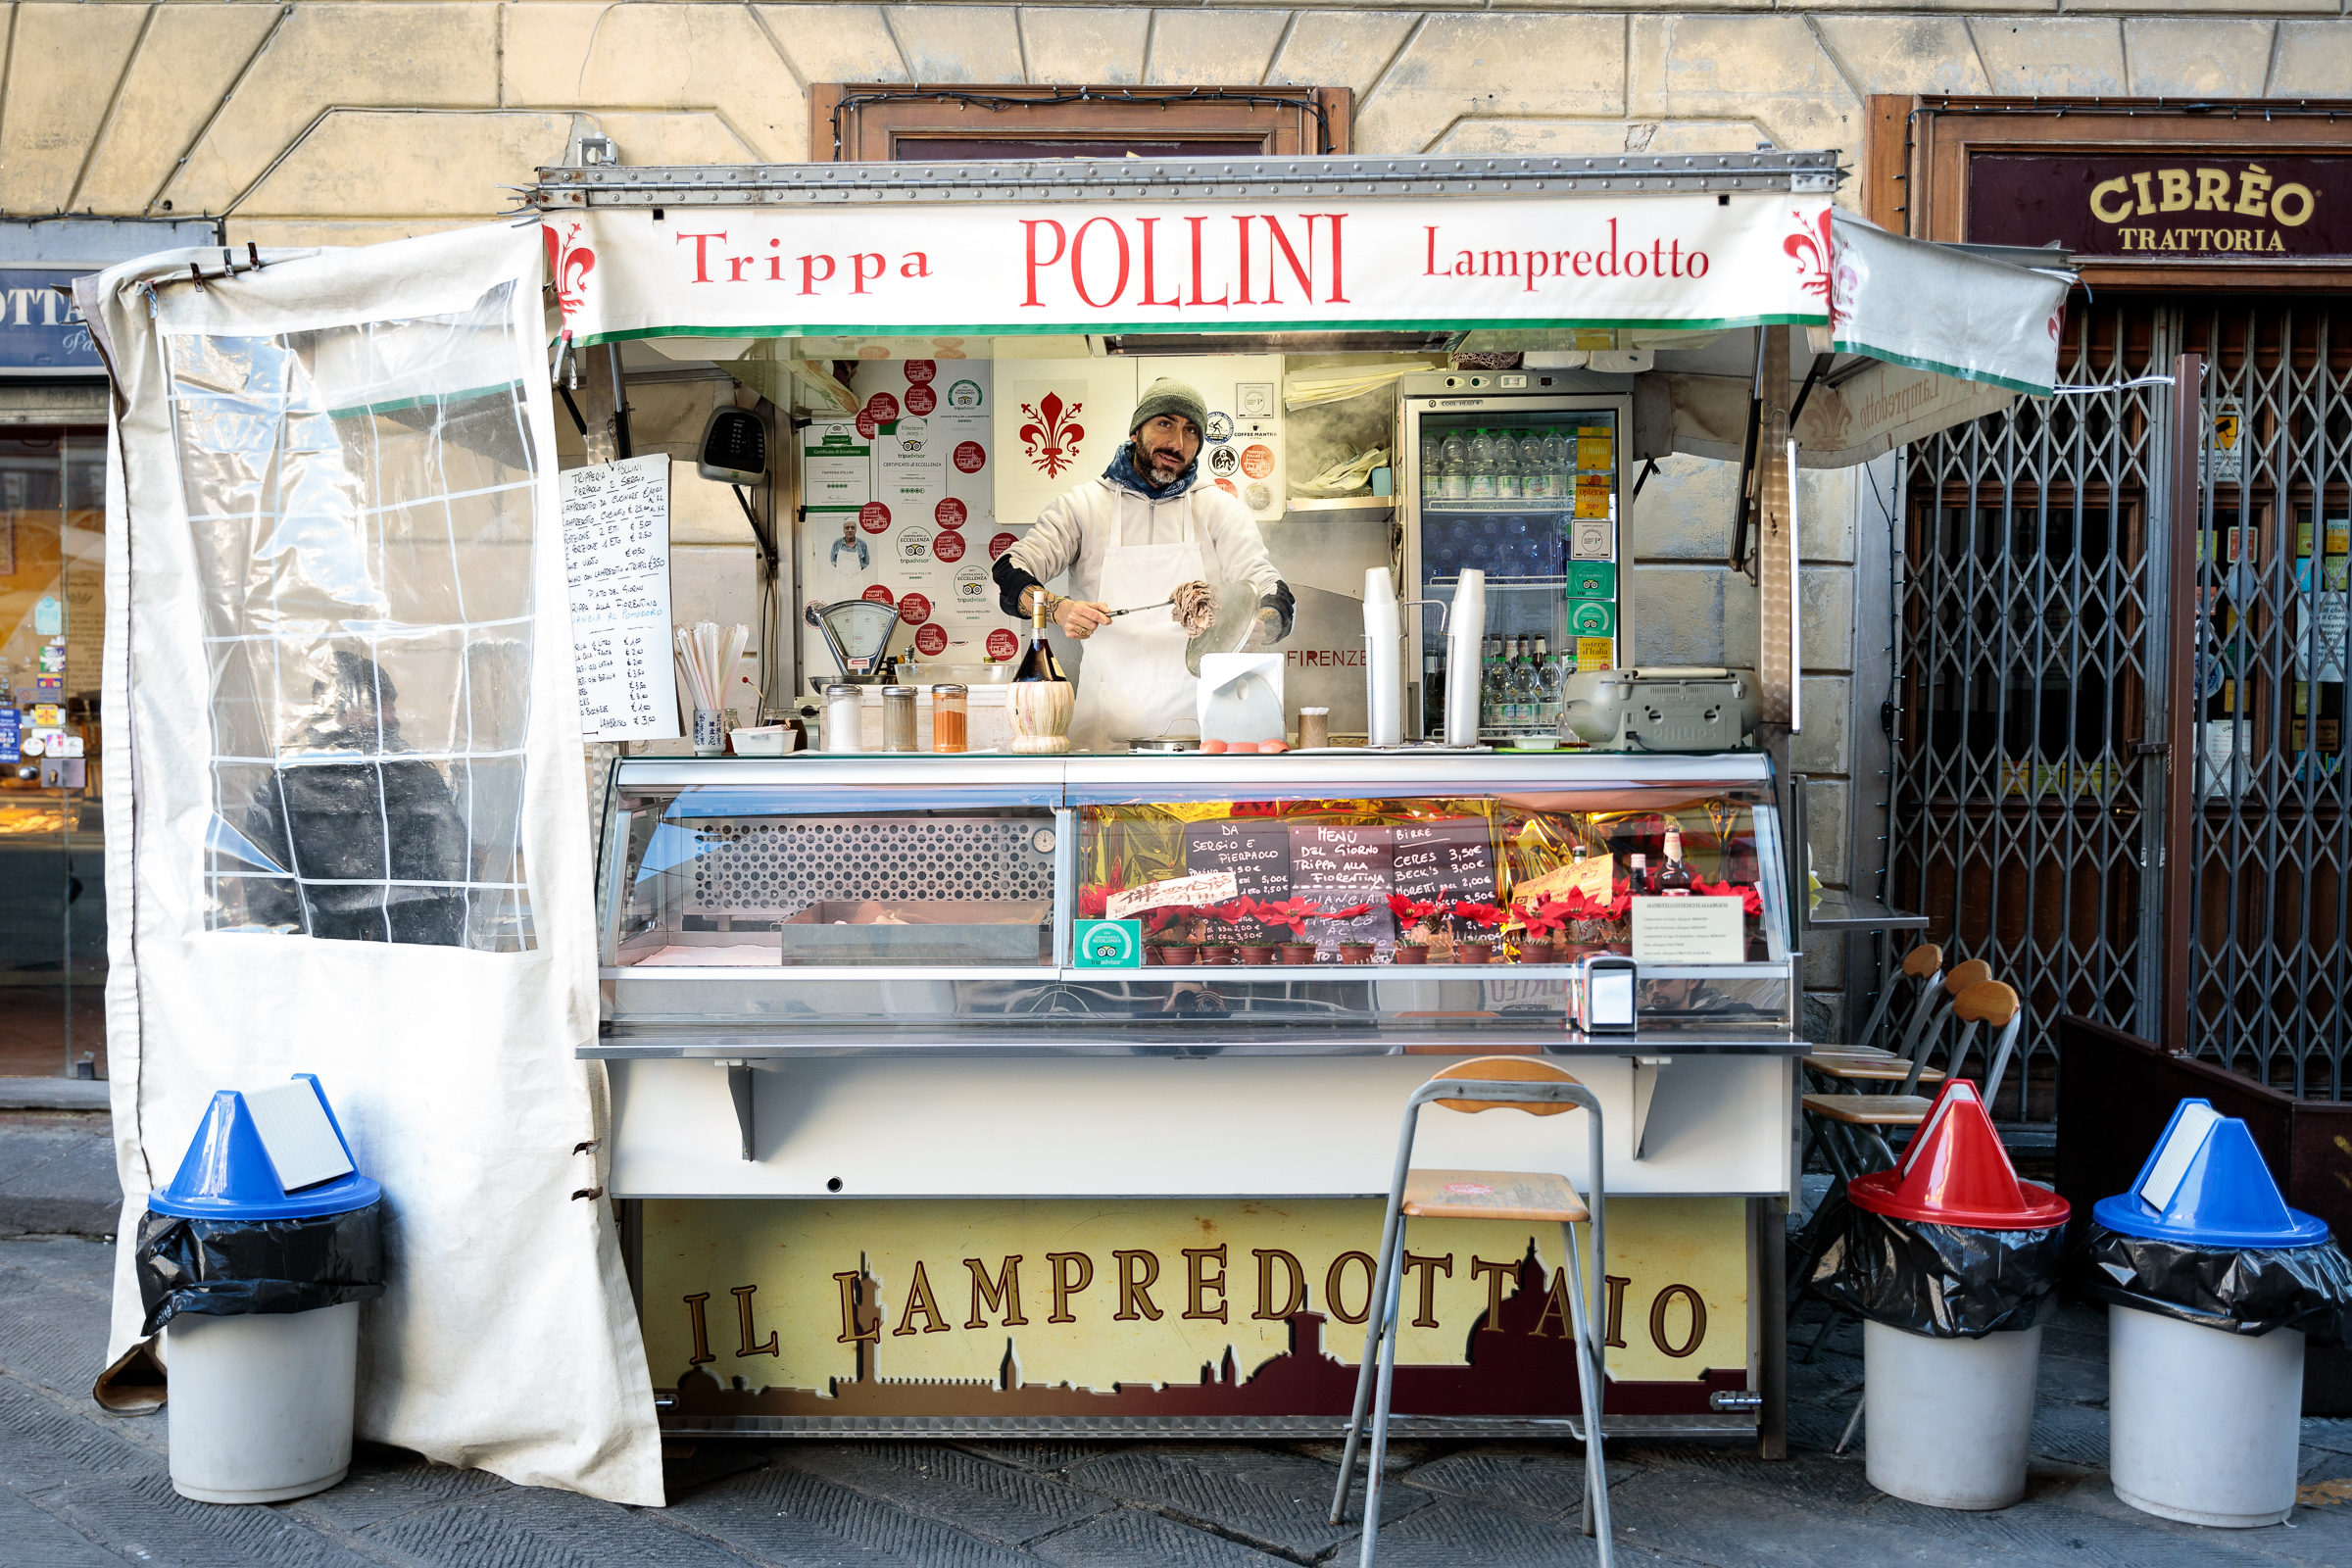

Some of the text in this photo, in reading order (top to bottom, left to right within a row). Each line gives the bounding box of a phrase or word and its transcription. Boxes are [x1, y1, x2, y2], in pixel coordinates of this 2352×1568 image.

[2090, 163, 2315, 226] CIBRÈO
[2118, 228, 2285, 251] TRATTORIA
[676, 213, 1709, 313] Trippa POLLINI Lampredotto
[1287, 650, 1366, 666] FIRENZE
[1221, 825, 1239, 835] DA
[1396, 828, 1432, 840] BIRRE
[1193, 839, 1255, 852] SERGIO E
[1301, 844, 1378, 857] DEL GIORNO
[1218, 850, 1278, 864] PIERPAOLO
[1394, 845, 1482, 868] CERES 3,50€
[1294, 859, 1369, 871] TRIPPA ALLA
[1395, 860, 1485, 882] BECK'S 3,00€
[1310, 873, 1385, 883] FIORENTINA
[1396, 876, 1492, 897] MORETTI 2,00€
[1464, 891, 1495, 905] 3,50€
[683, 1243, 1707, 1366] IL LAMPREDOTTAIO
